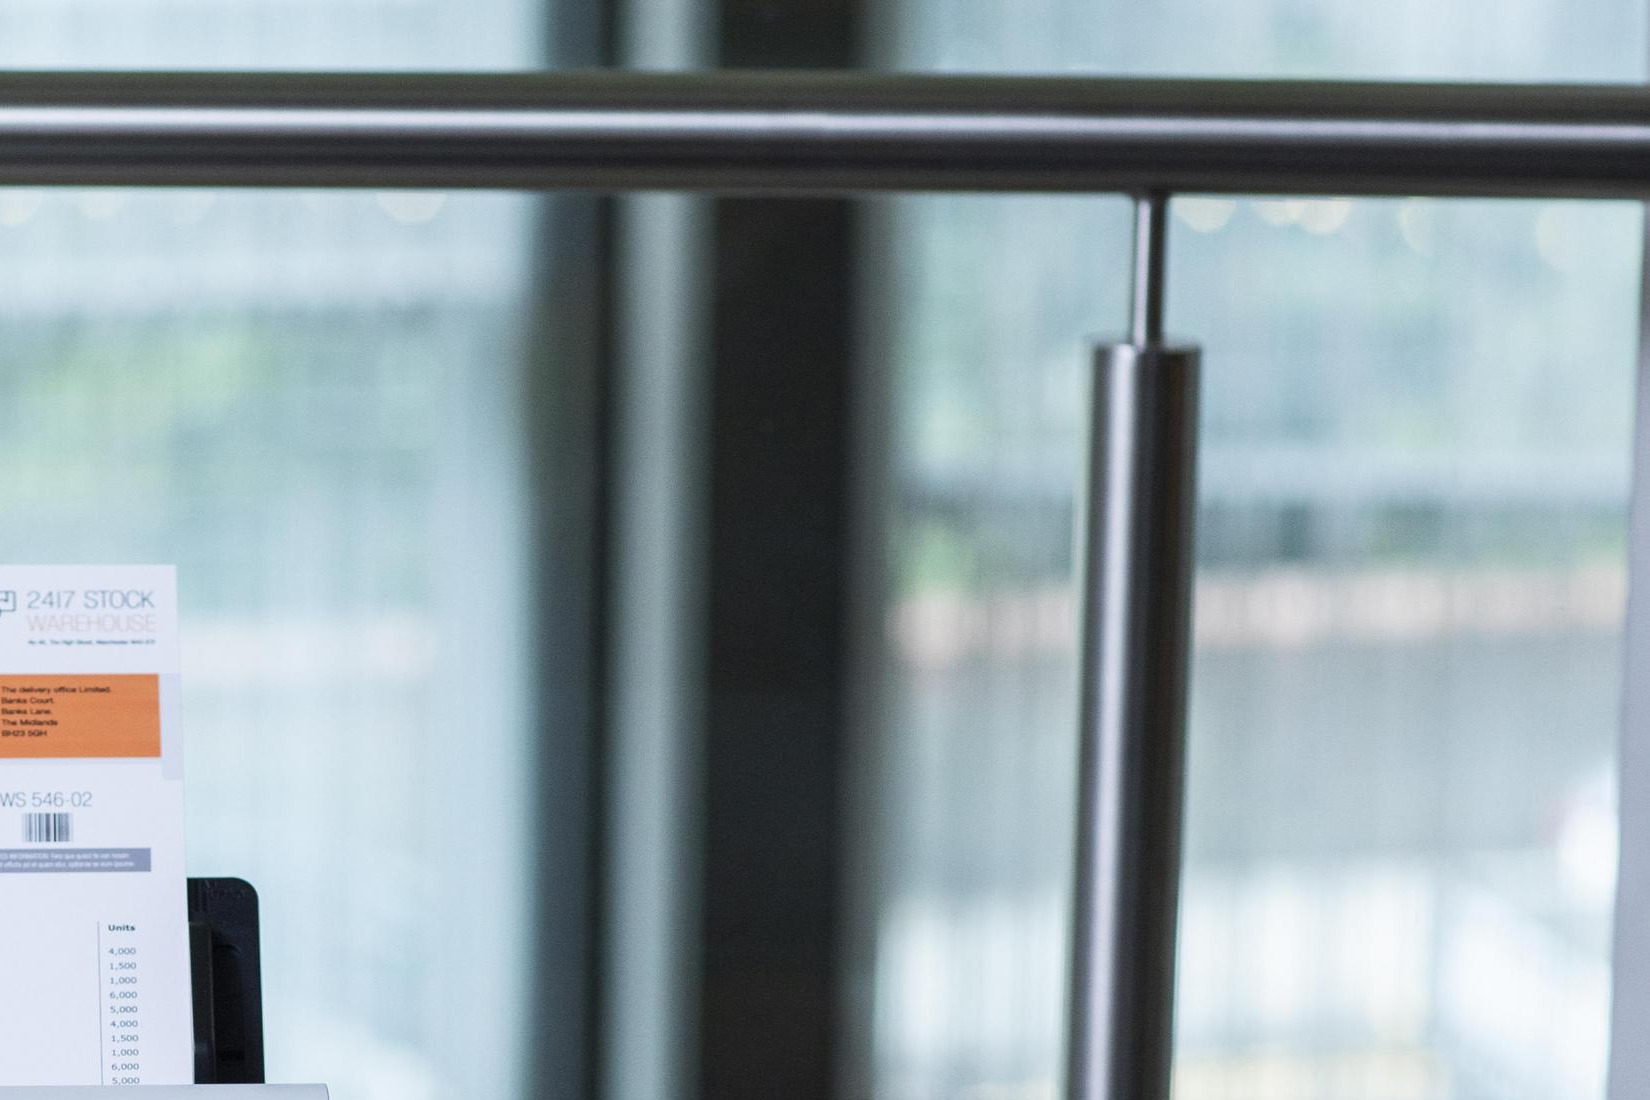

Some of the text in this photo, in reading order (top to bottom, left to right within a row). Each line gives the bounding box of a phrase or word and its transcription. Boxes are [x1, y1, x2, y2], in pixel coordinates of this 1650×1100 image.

[84, 590, 154, 609] STOCK
[26, 614, 156, 632] WAREHOUSE
[19, 687, 50, 695] delivery
[0, 791, 92, 807] WS 546-02
[108, 948, 136, 956] 4,000
[110, 962, 136, 970] 1,500
[110, 977, 137, 985] 1,000
[110, 992, 138, 1000] 6,000
[110, 1006, 138, 1014] 5,000
[110, 1020, 138, 1028] 4,000
[112, 1035, 138, 1043] 1,500
[112, 1049, 139, 1057] 1,000
[112, 1063, 139, 1071] 6,000
[112, 1077, 140, 1085] 5,000
